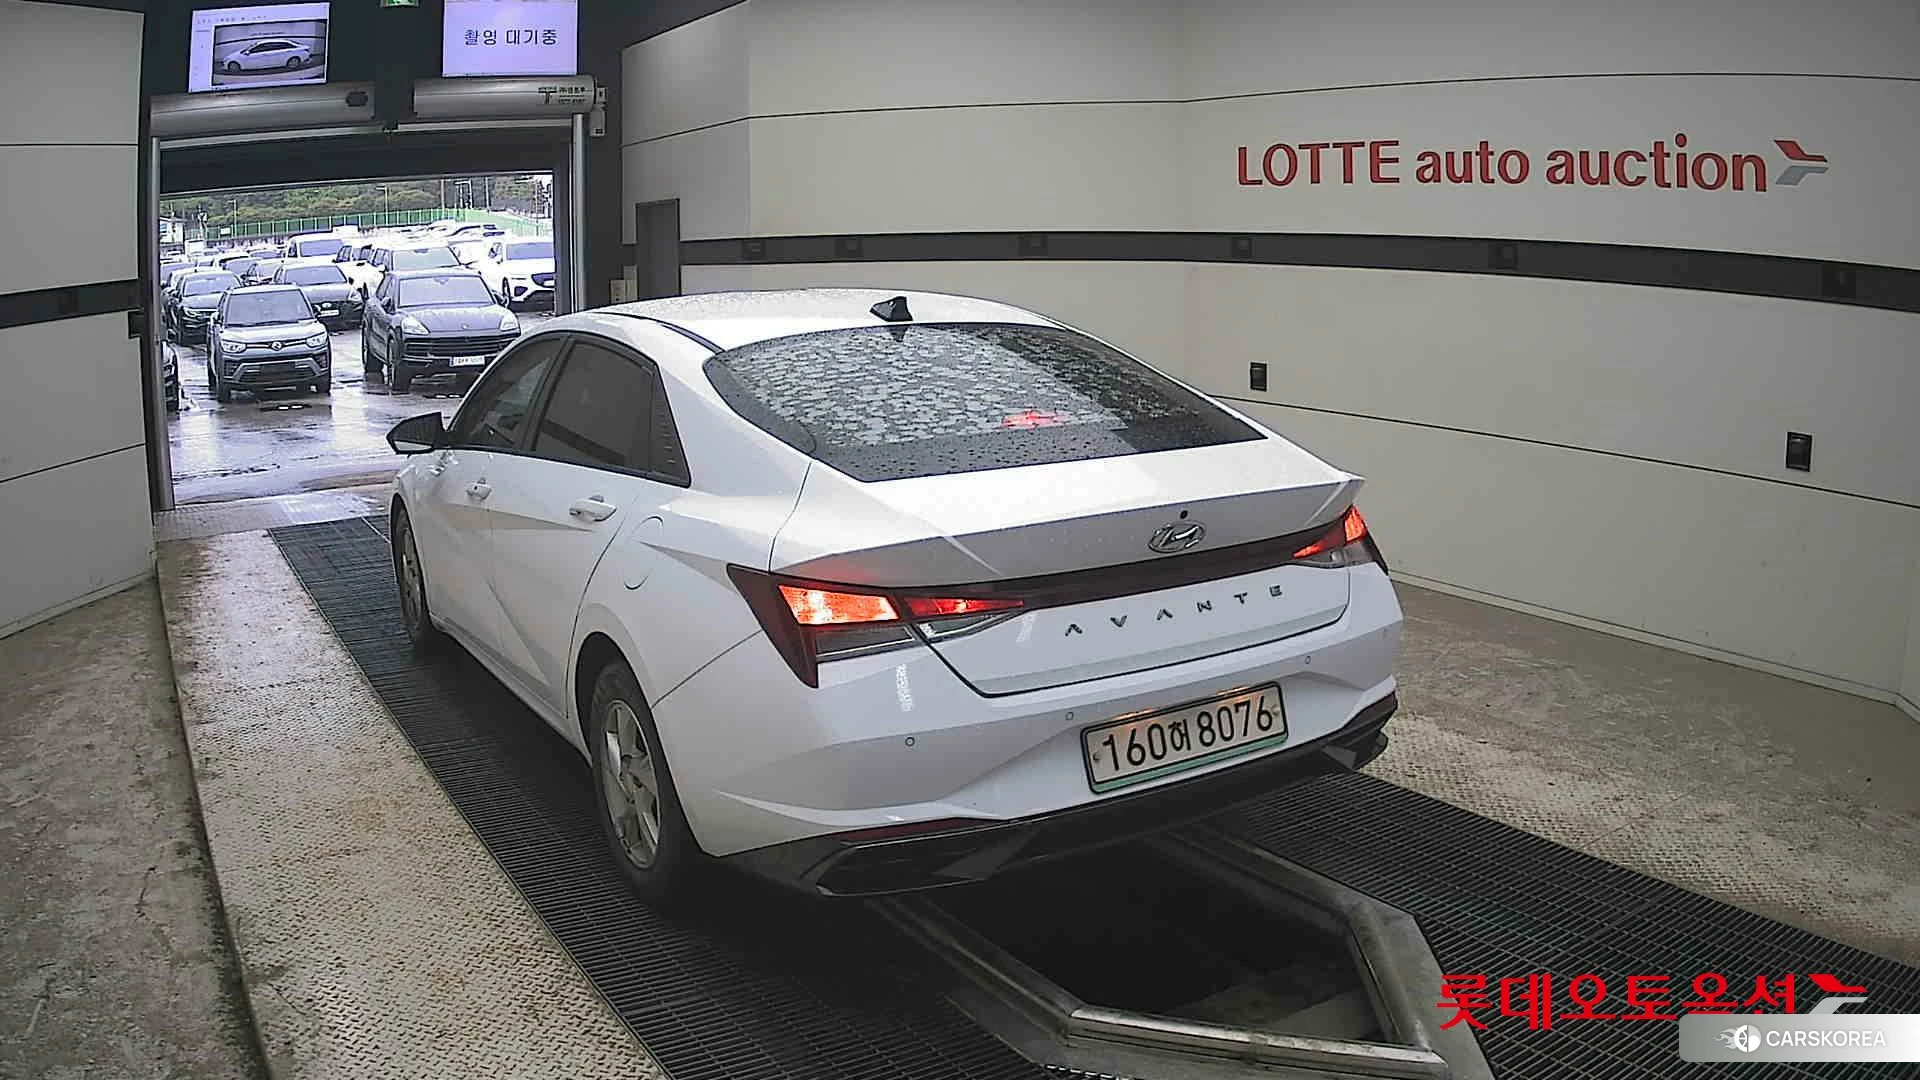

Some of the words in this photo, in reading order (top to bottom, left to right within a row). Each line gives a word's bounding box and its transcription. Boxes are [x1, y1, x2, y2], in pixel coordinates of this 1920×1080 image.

[505, 29, 557, 46] 대기중
[1238, 140, 1400, 186] LOTTE
[1415, 140, 1530, 185] auto
[1545, 133, 1767, 193] auction
[1064, 584, 1282, 637] AVANTE
[1102, 719, 1192, 772] 160허
[1196, 695, 1273, 748] 8076
